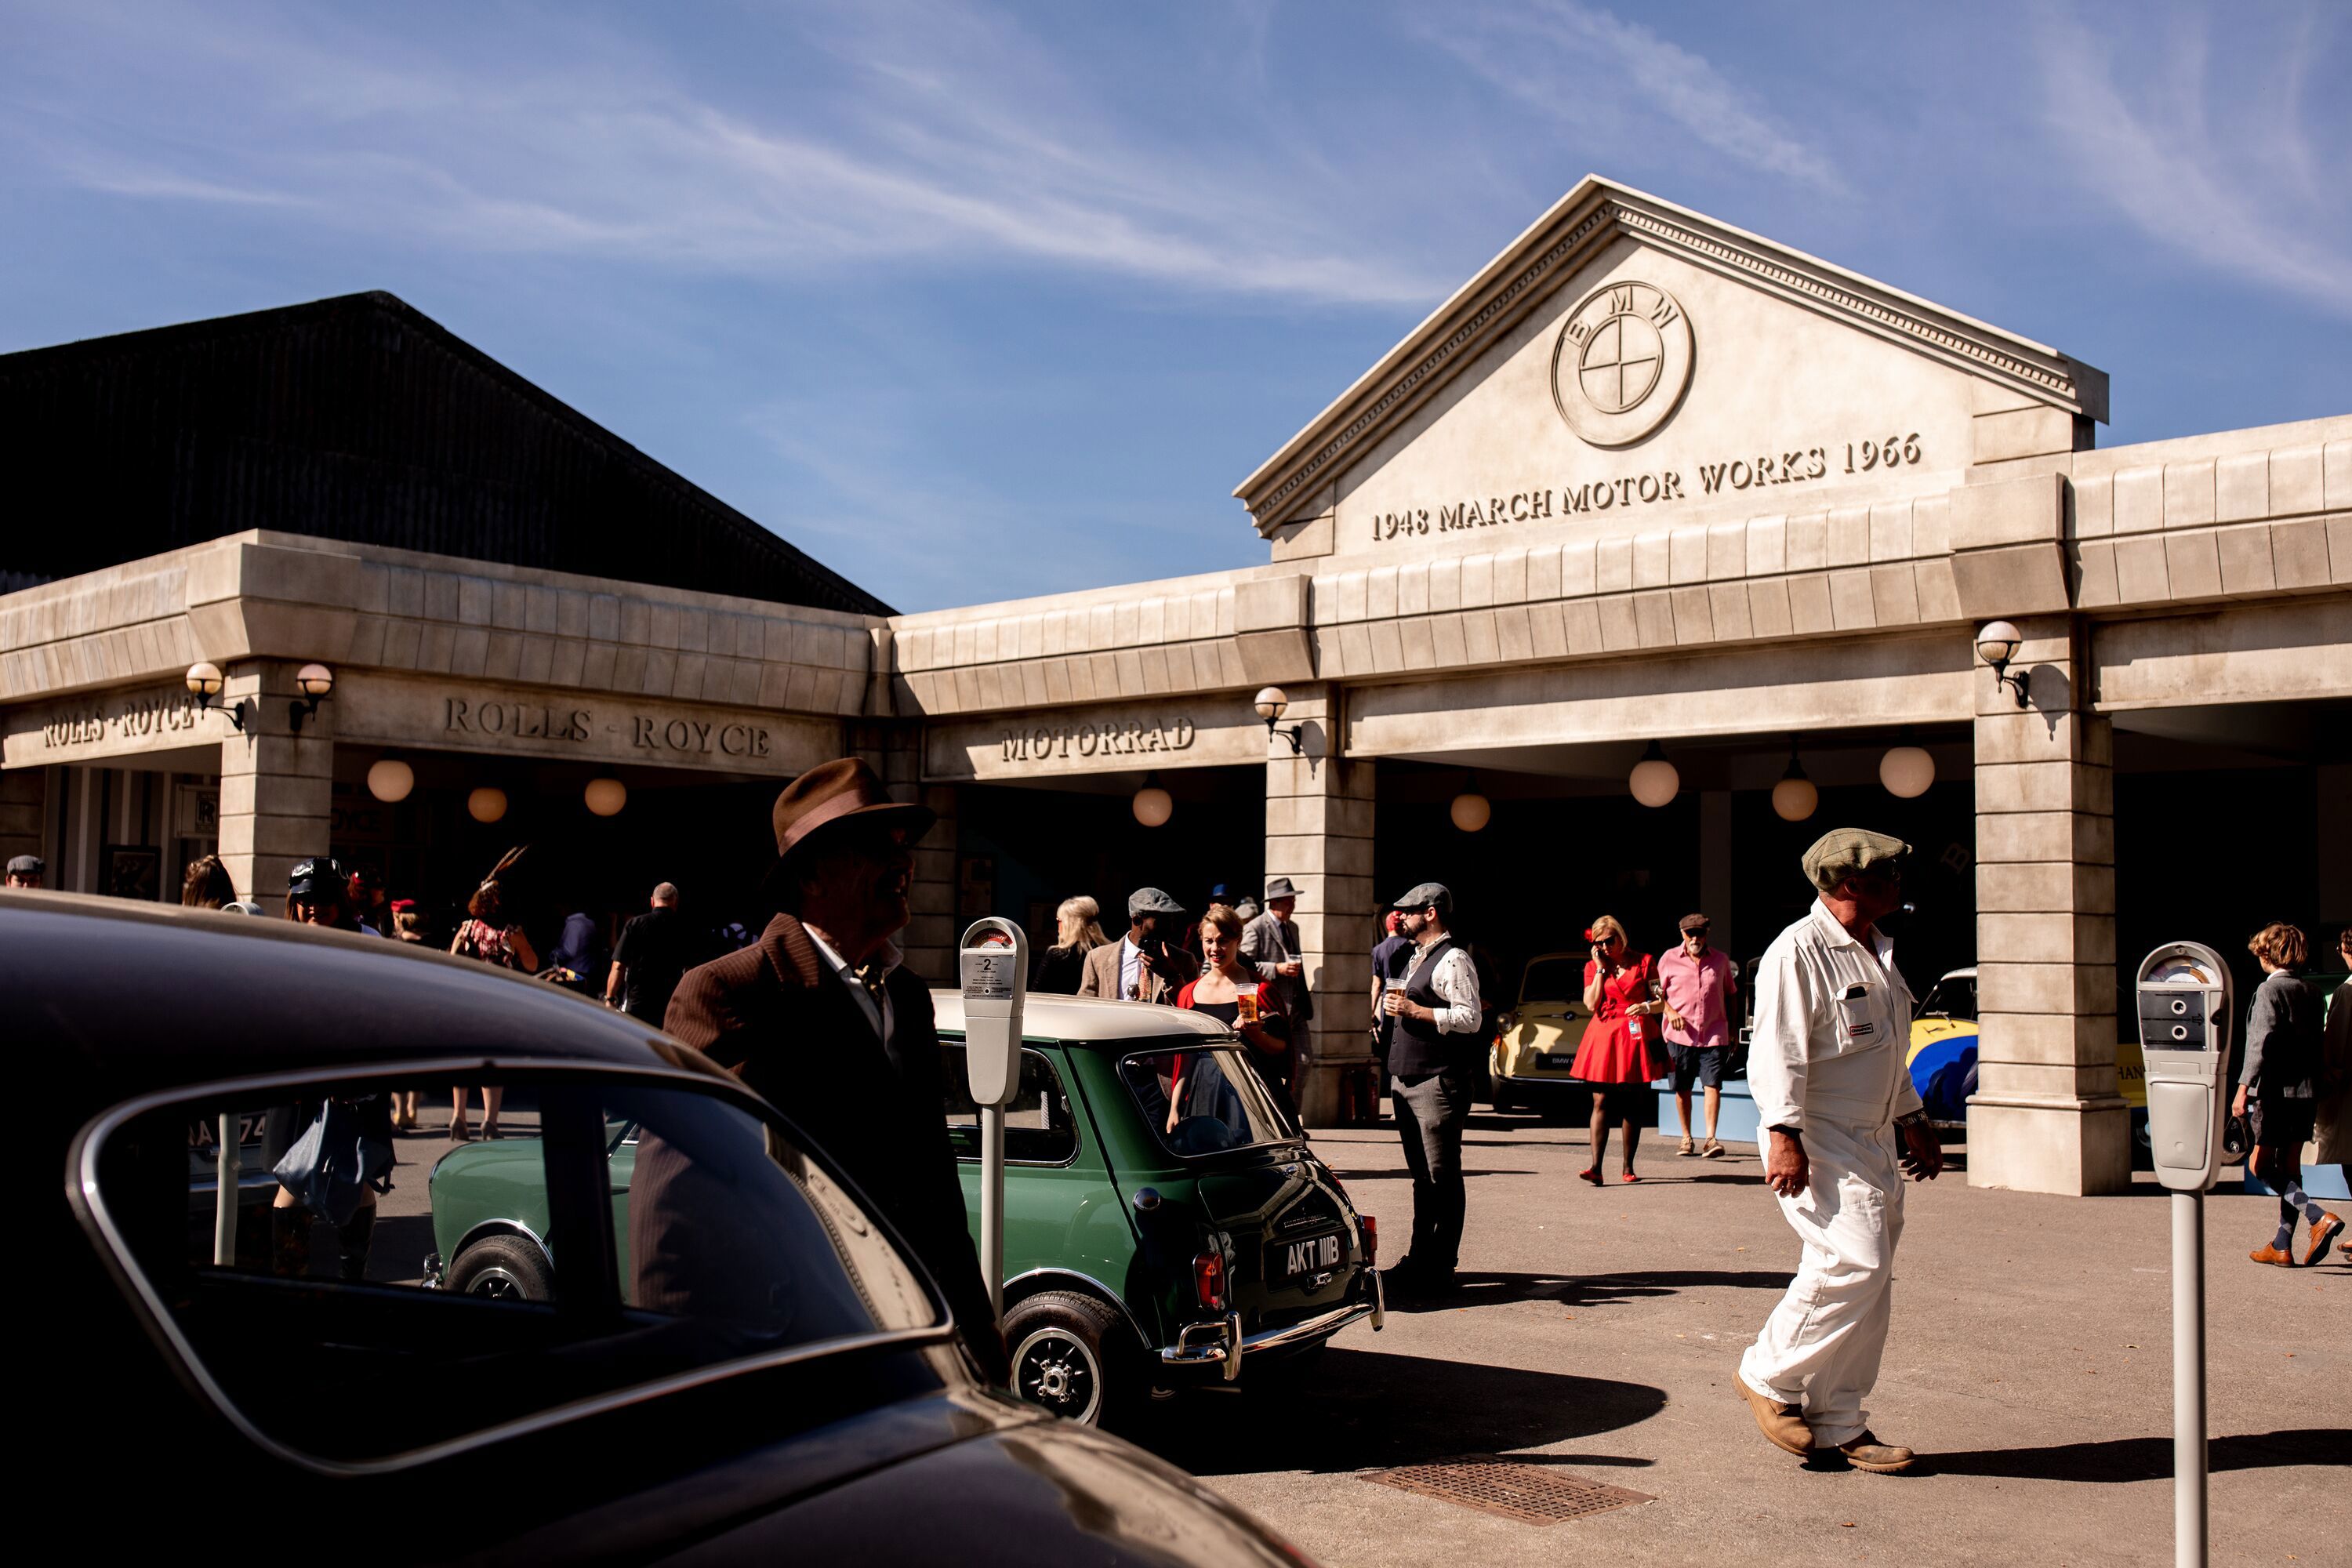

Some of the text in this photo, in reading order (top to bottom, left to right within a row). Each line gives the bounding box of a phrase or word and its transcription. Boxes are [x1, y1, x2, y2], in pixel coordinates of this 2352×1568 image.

[1564, 285, 1679, 347] BMW
[1372, 433, 1921, 541] 1948 MARCH MOTOR WORKS 1966
[1002, 717, 1195, 762] MOTORRAD
[983, 958, 992, 971] 2
[1287, 1240, 1316, 1276] AKT
